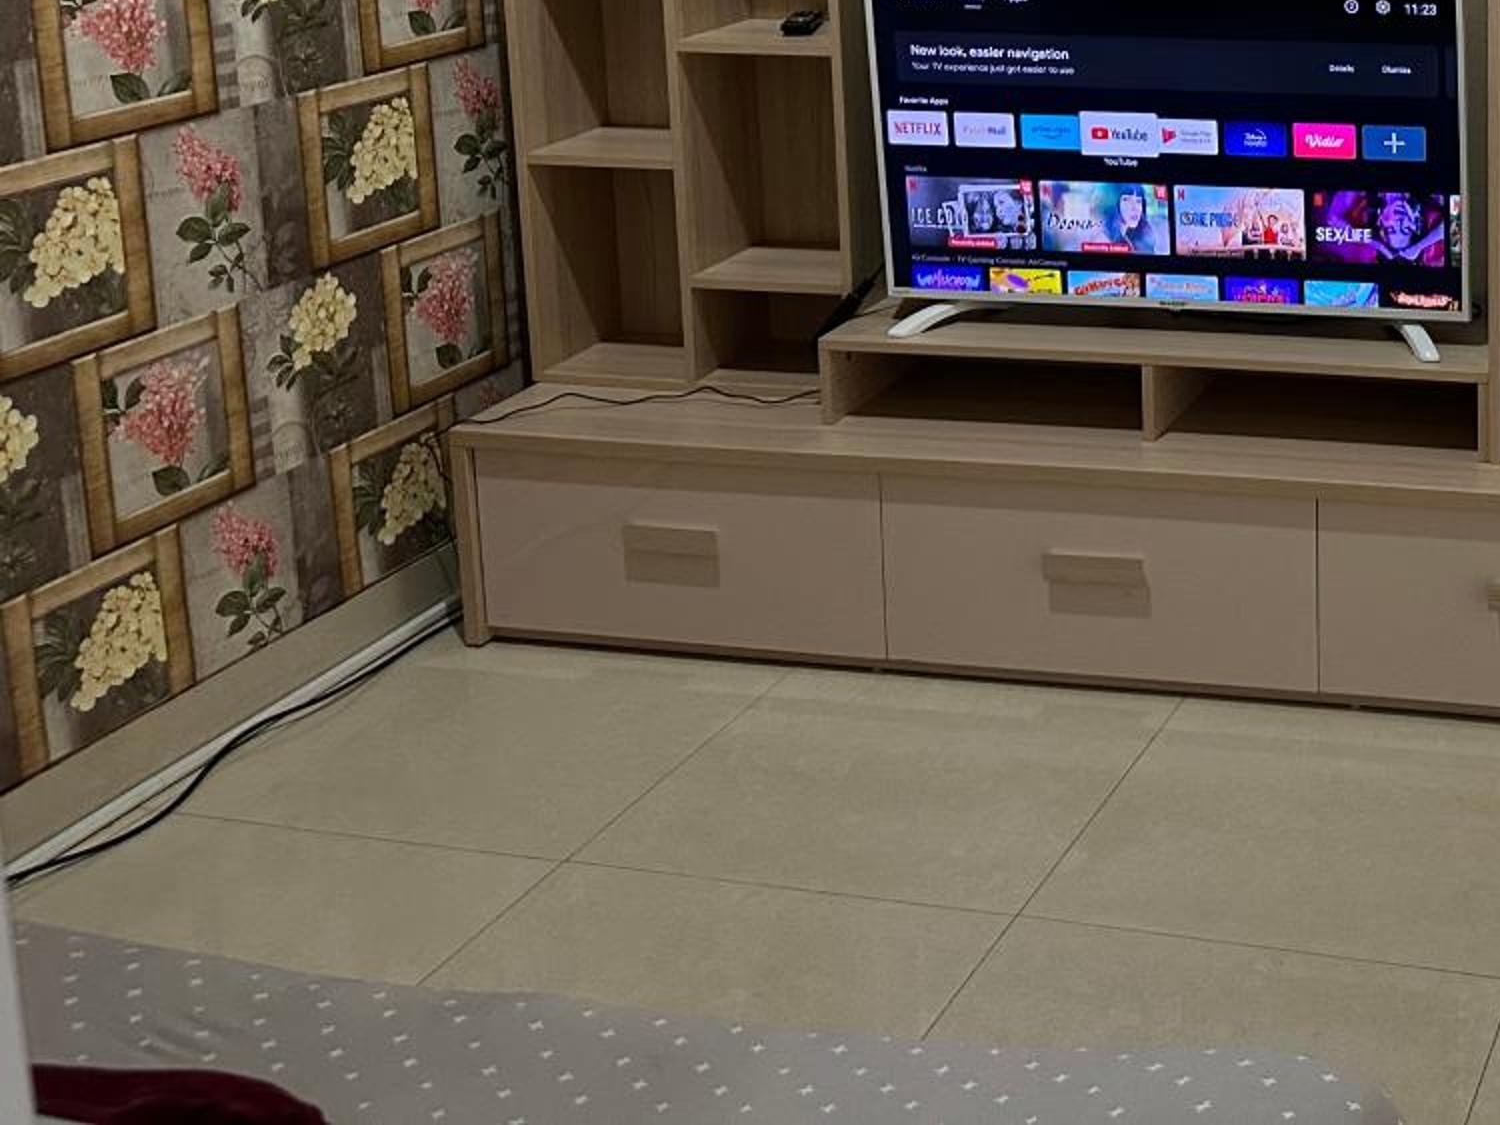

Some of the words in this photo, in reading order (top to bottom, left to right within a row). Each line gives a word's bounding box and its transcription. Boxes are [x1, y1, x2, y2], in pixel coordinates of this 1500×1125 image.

[1403, 3, 1438, 17] 11:23
[910, 43, 937, 56] New
[938, 44, 967, 58] look,
[969, 46, 1004, 58] easier
[1006, 46, 1070, 62] navigation
[894, 122, 942, 136] NETFLIX
[1111, 128, 1149, 142] YouTube
[1103, 156, 1139, 168] YouTube
